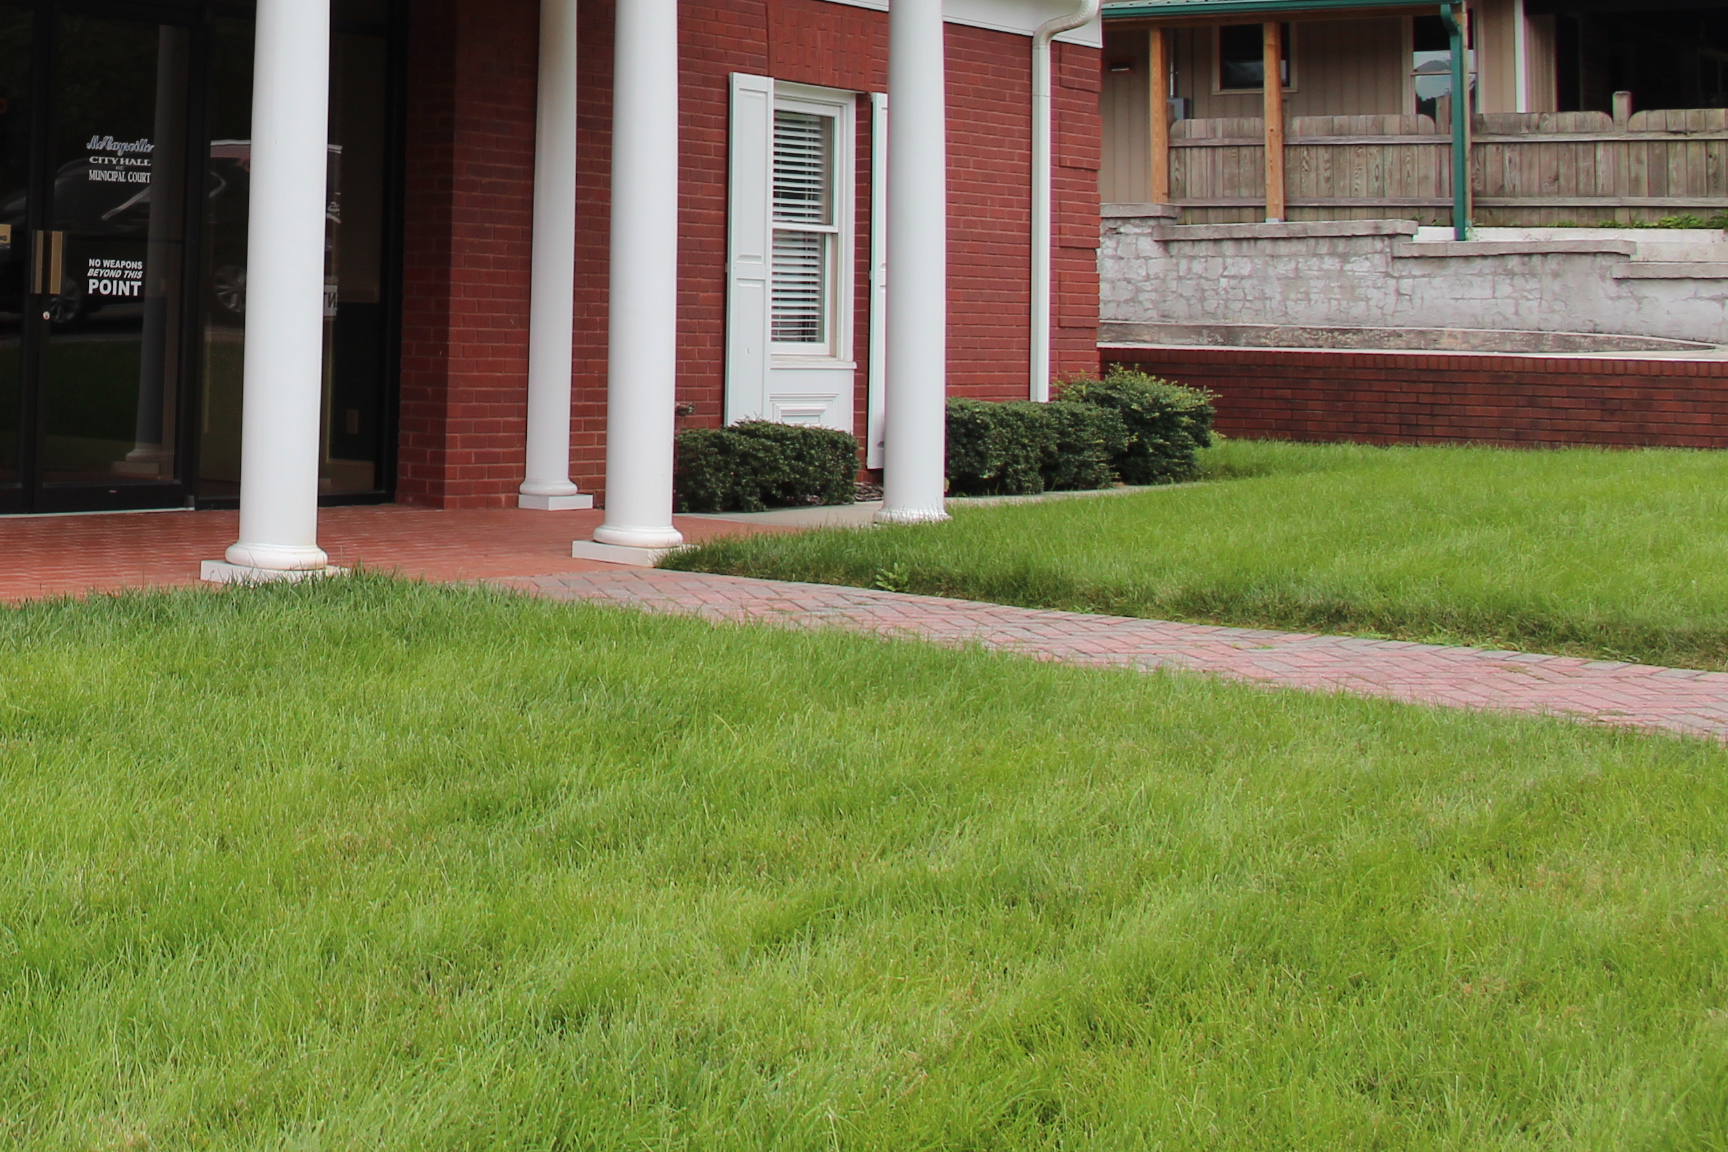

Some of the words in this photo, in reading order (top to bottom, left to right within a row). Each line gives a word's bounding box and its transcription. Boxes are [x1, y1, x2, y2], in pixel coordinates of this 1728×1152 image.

[88, 155, 119, 165] CITY
[121, 157, 152, 167] HALL
[88, 169, 127, 183] MUNICIPAL
[127, 171, 152, 184] COURT
[88, 258, 102, 268] NO
[102, 259, 143, 270] WEAPONS
[86, 268, 122, 278] BEYOND
[122, 269, 143, 279] THIS
[87, 278, 143, 297] POINT
